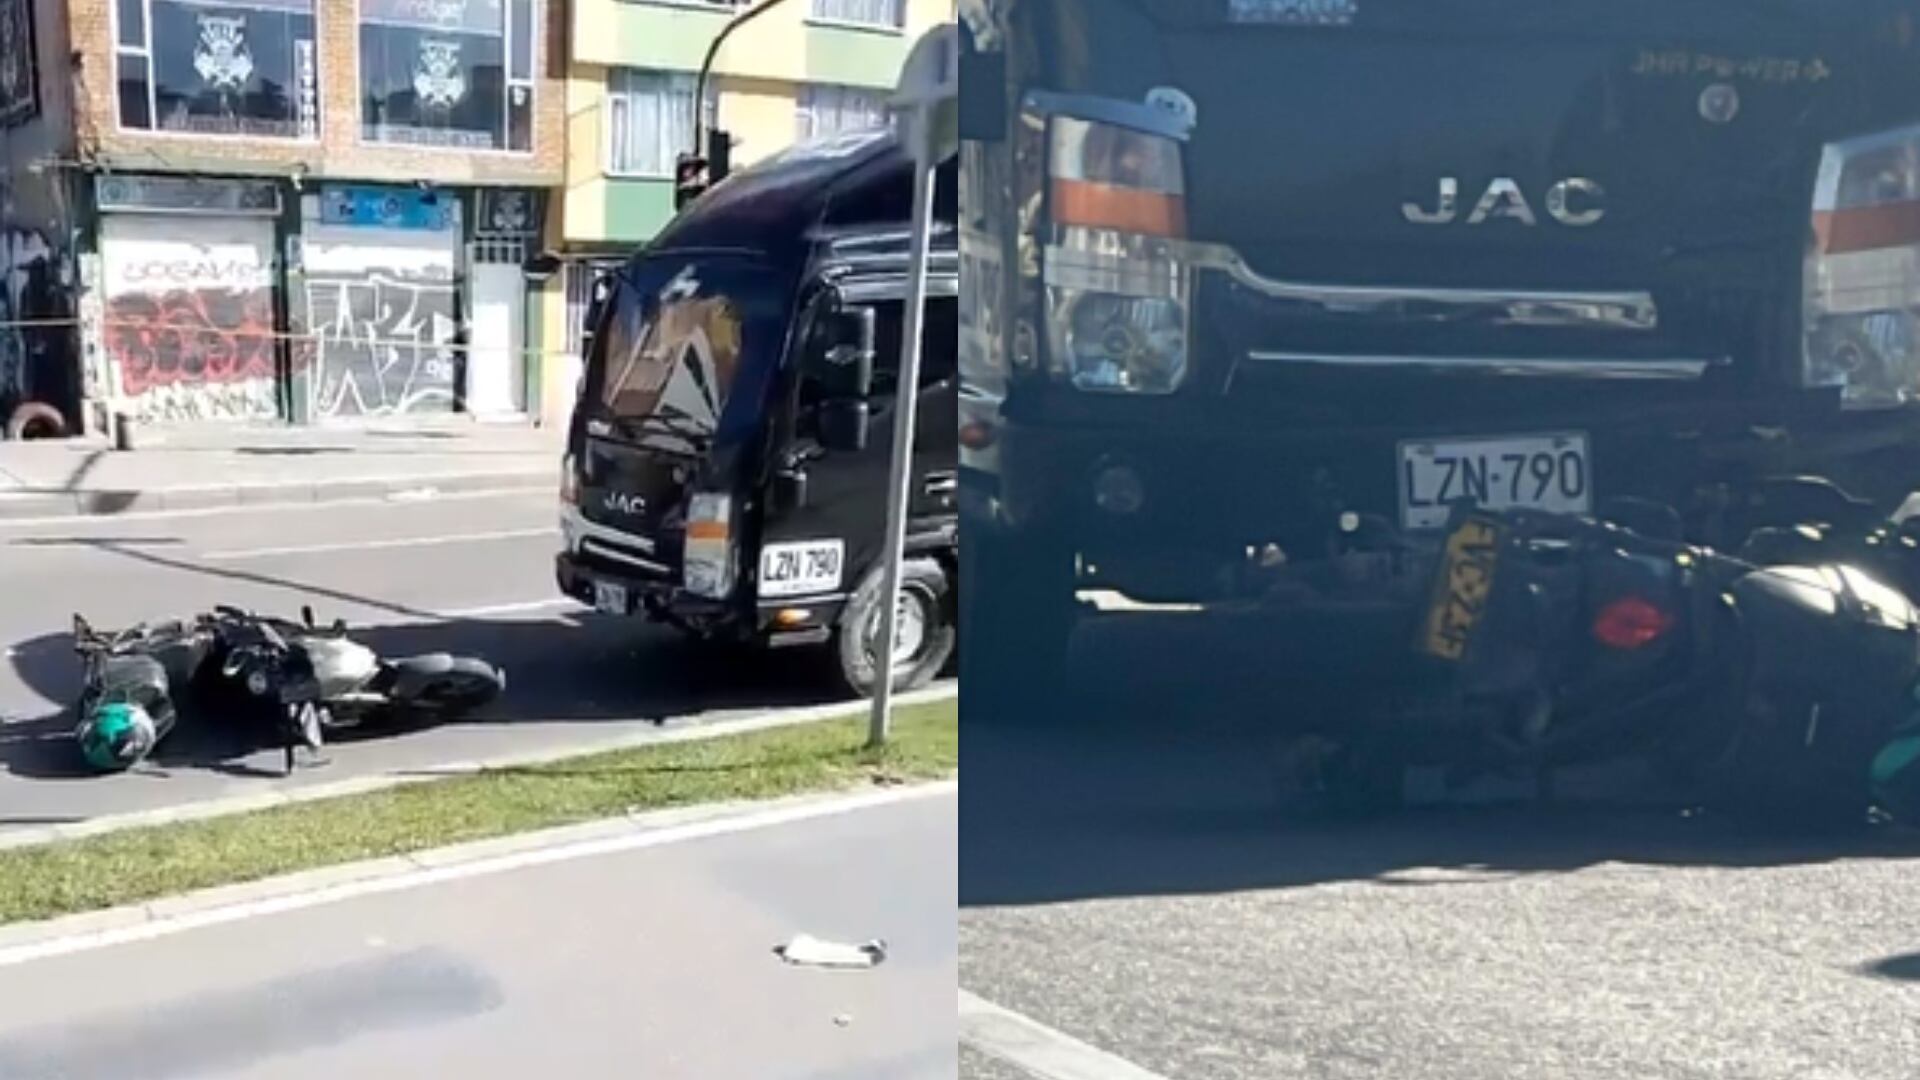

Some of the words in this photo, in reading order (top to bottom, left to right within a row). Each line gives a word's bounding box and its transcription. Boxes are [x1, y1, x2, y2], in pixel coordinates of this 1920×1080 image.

[1402, 177, 1606, 226] JAC
[603, 491, 647, 515] JAC
[764, 550, 800, 581] LZN
